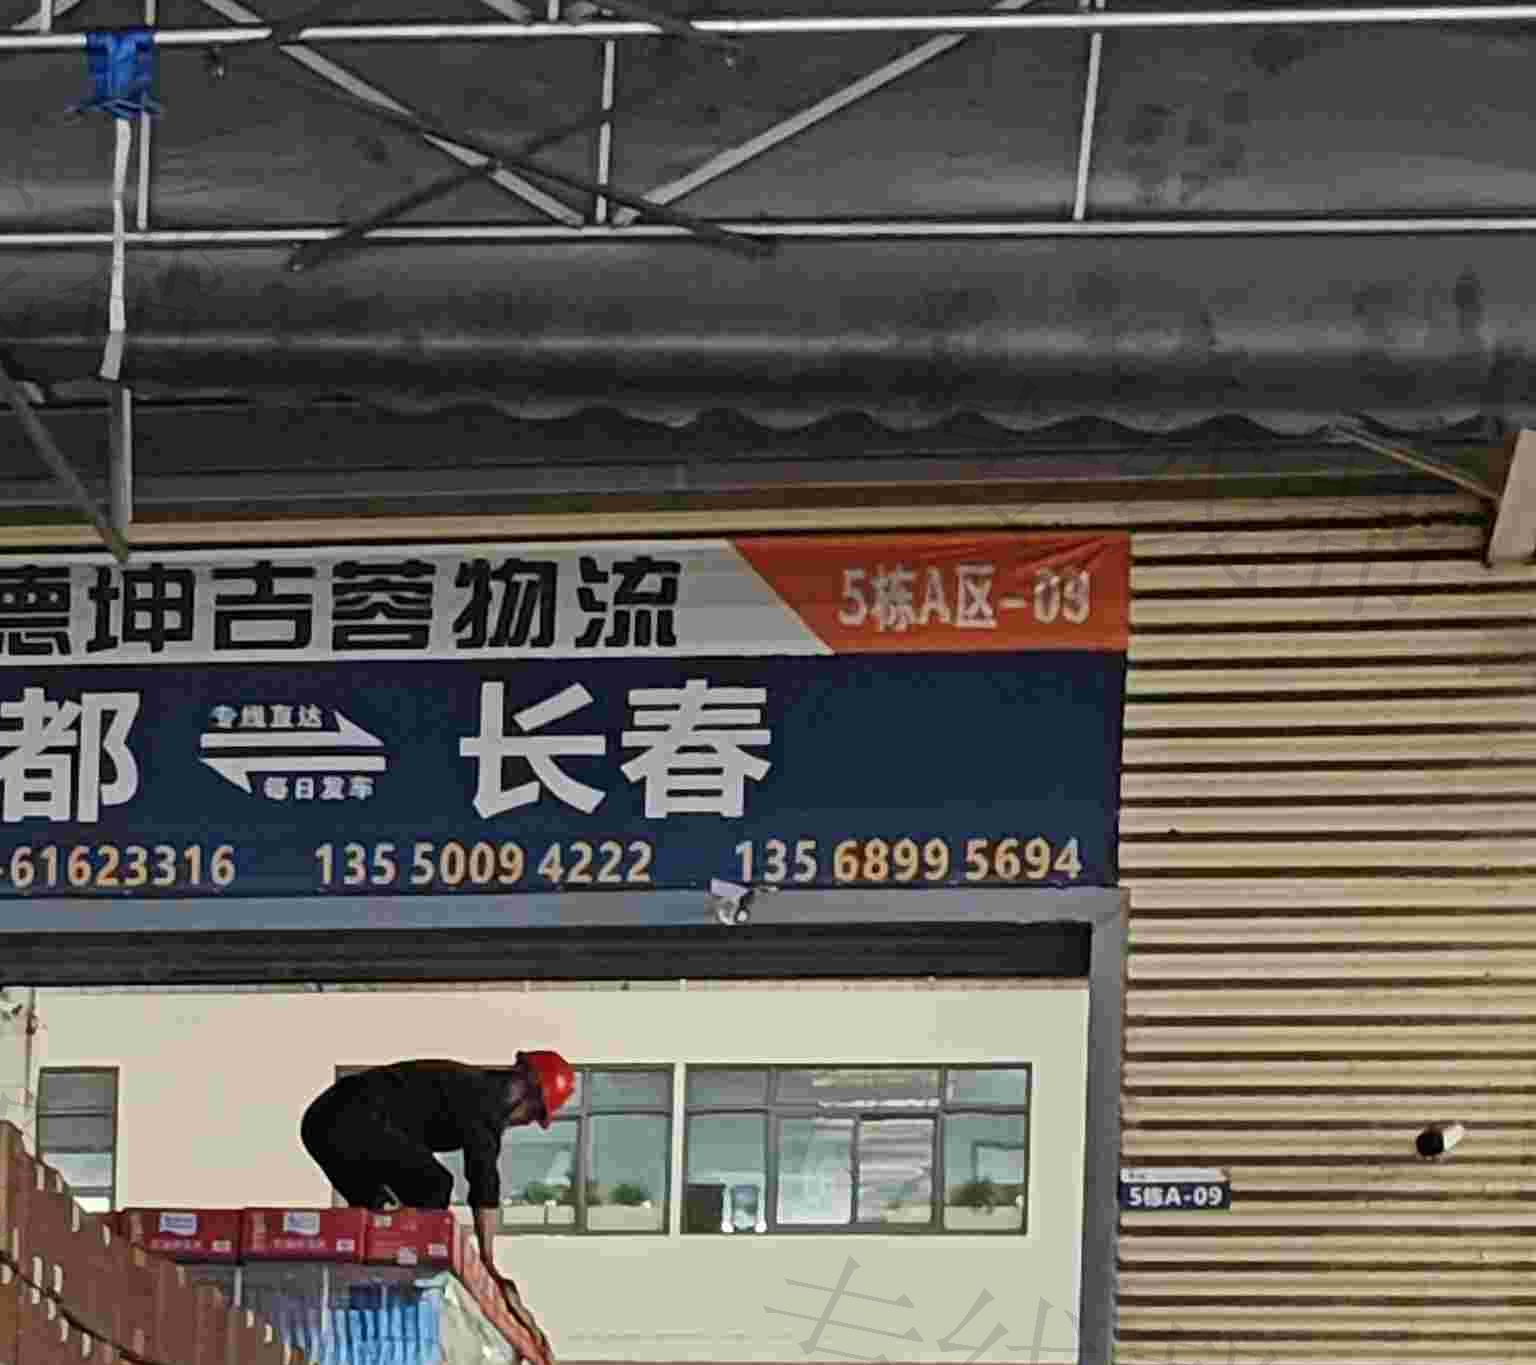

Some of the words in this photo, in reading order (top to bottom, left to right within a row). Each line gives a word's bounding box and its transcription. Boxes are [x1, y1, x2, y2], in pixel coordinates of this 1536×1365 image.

[838, 562, 1091, 633] 5栋A区-09
[459, 680, 772, 819] 长春
[315, 841, 396, 885] 135
[410, 841, 523, 885] 5009
[537, 841, 654, 884] 4222
[735, 839, 817, 882] 135
[832, 837, 950, 881] 6899
[963, 836, 1082, 880] 5694
